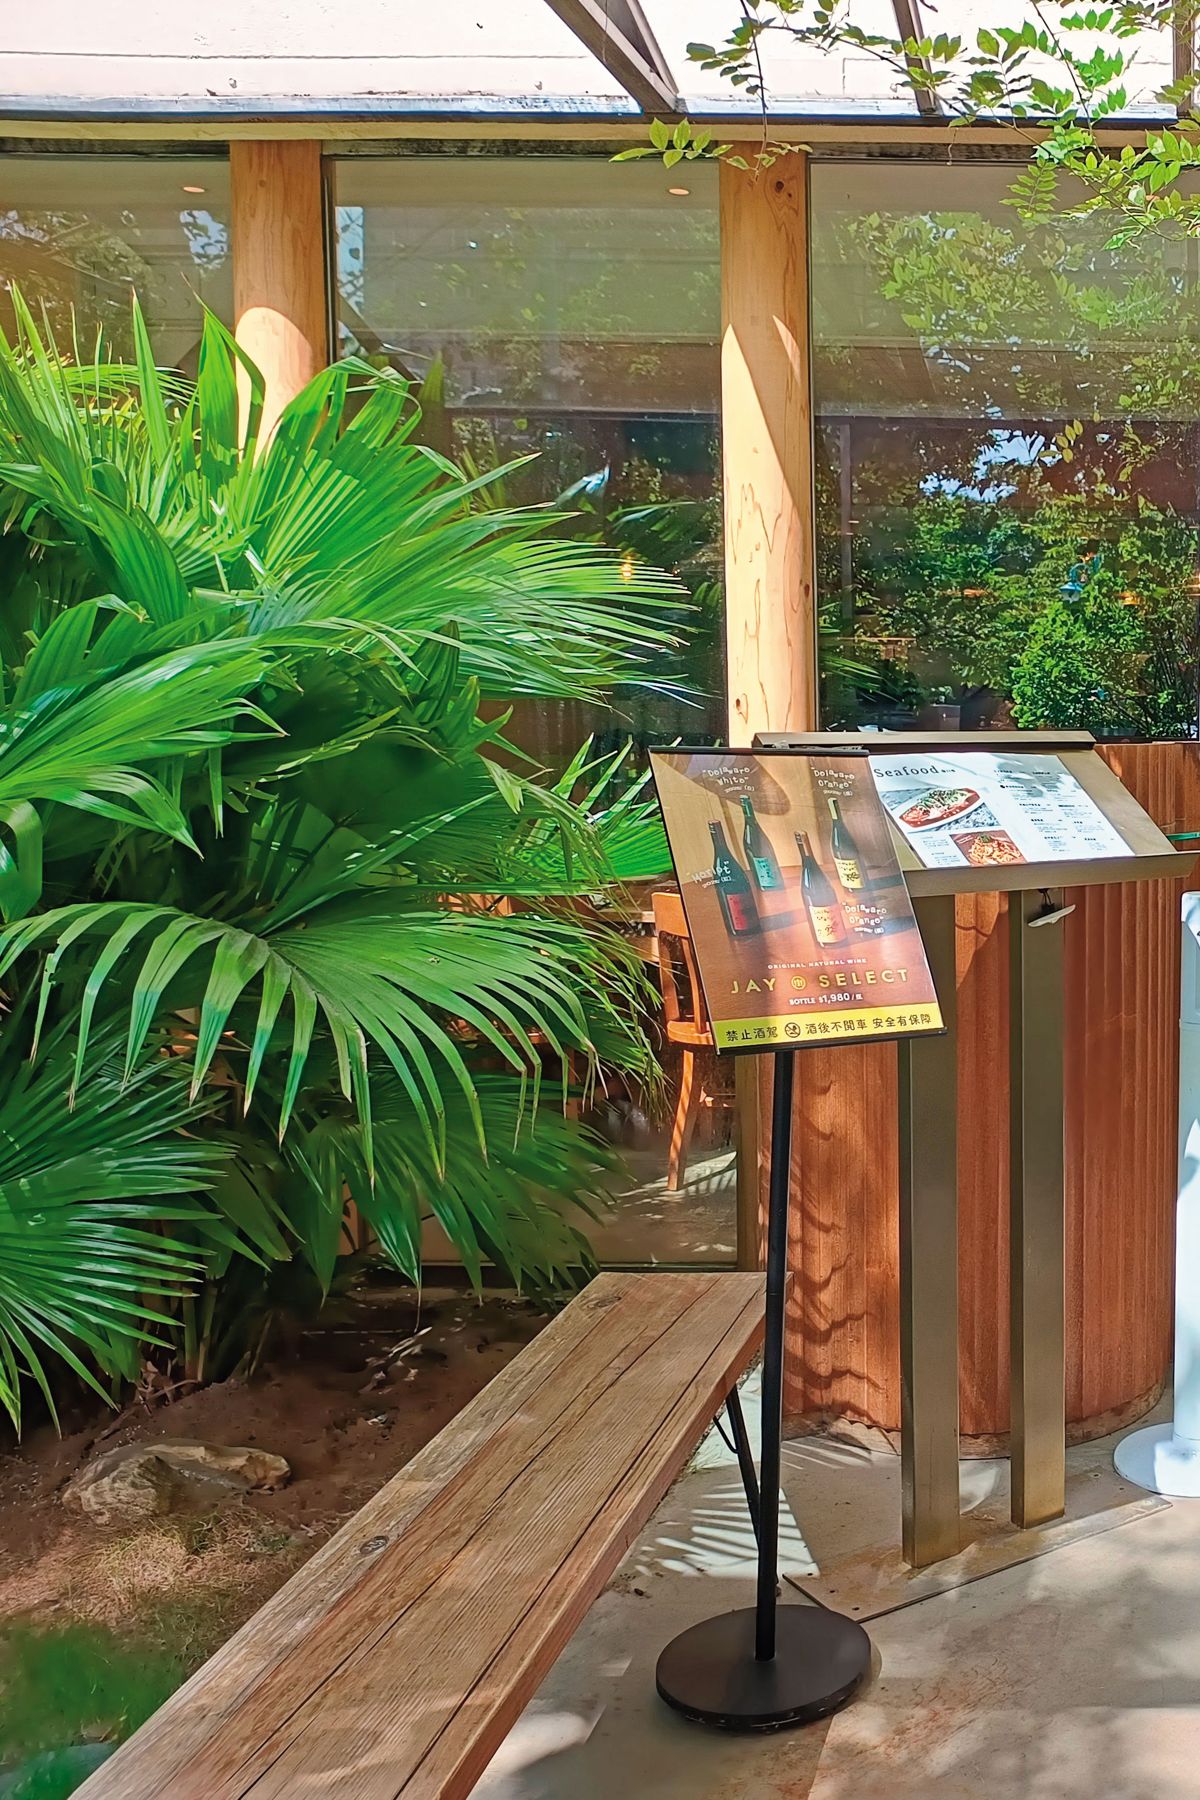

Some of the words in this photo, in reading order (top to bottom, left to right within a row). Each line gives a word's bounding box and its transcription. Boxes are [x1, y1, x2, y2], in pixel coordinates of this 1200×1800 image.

[873, 765, 939, 778] Seafood
[731, 978, 777, 994] JAY
[819, 969, 908, 988] SELECT
[789, 997, 816, 1006] BOTTLE
[818, 992, 850, 1004] $1,980
[805, 1019, 867, 1035] 酒後不開車
[872, 1013, 932, 1028] 安全有保障
[726, 1026, 778, 1042] 禁止酒駕
